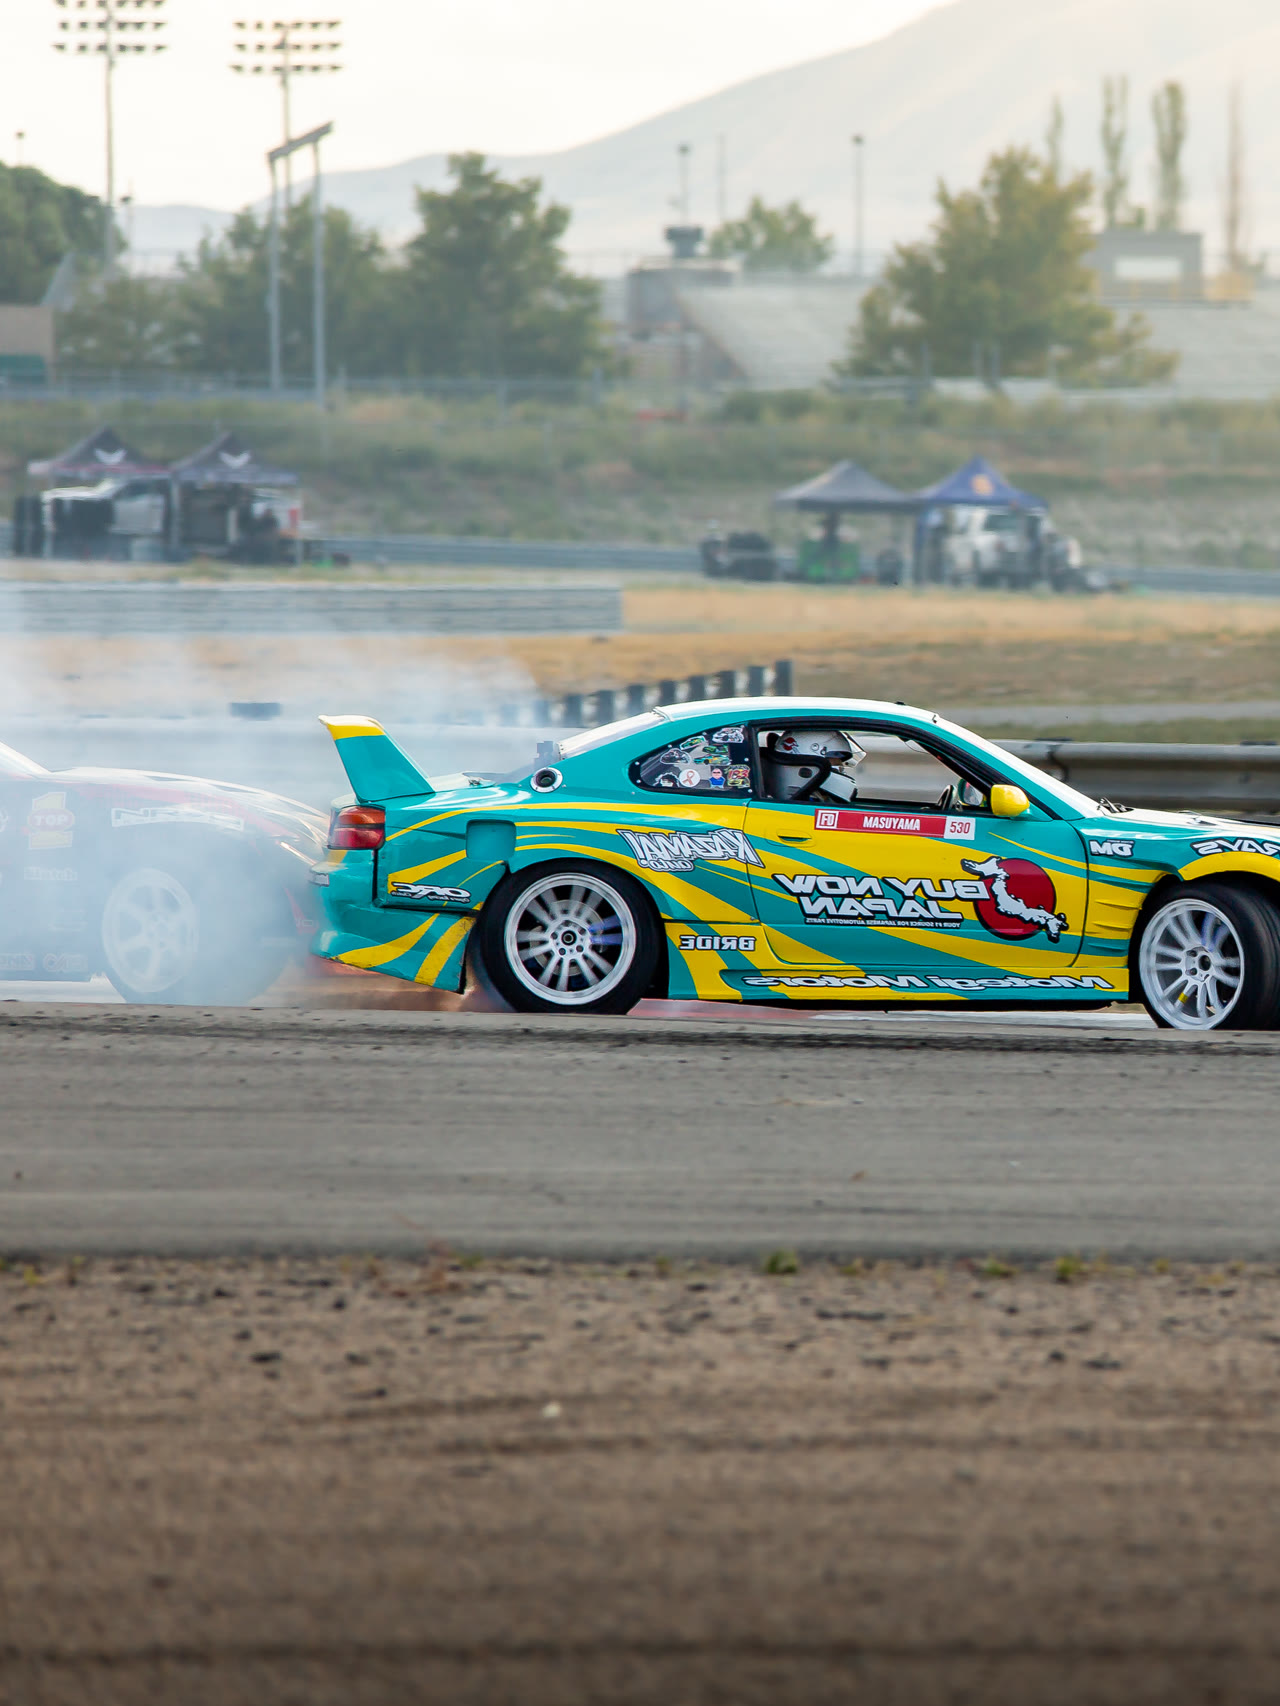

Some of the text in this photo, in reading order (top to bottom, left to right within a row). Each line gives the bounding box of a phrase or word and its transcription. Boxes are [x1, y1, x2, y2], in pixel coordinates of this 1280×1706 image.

[34, 814, 69, 827] TOP
[820, 813, 971, 834] FD MASUYAMA 530
